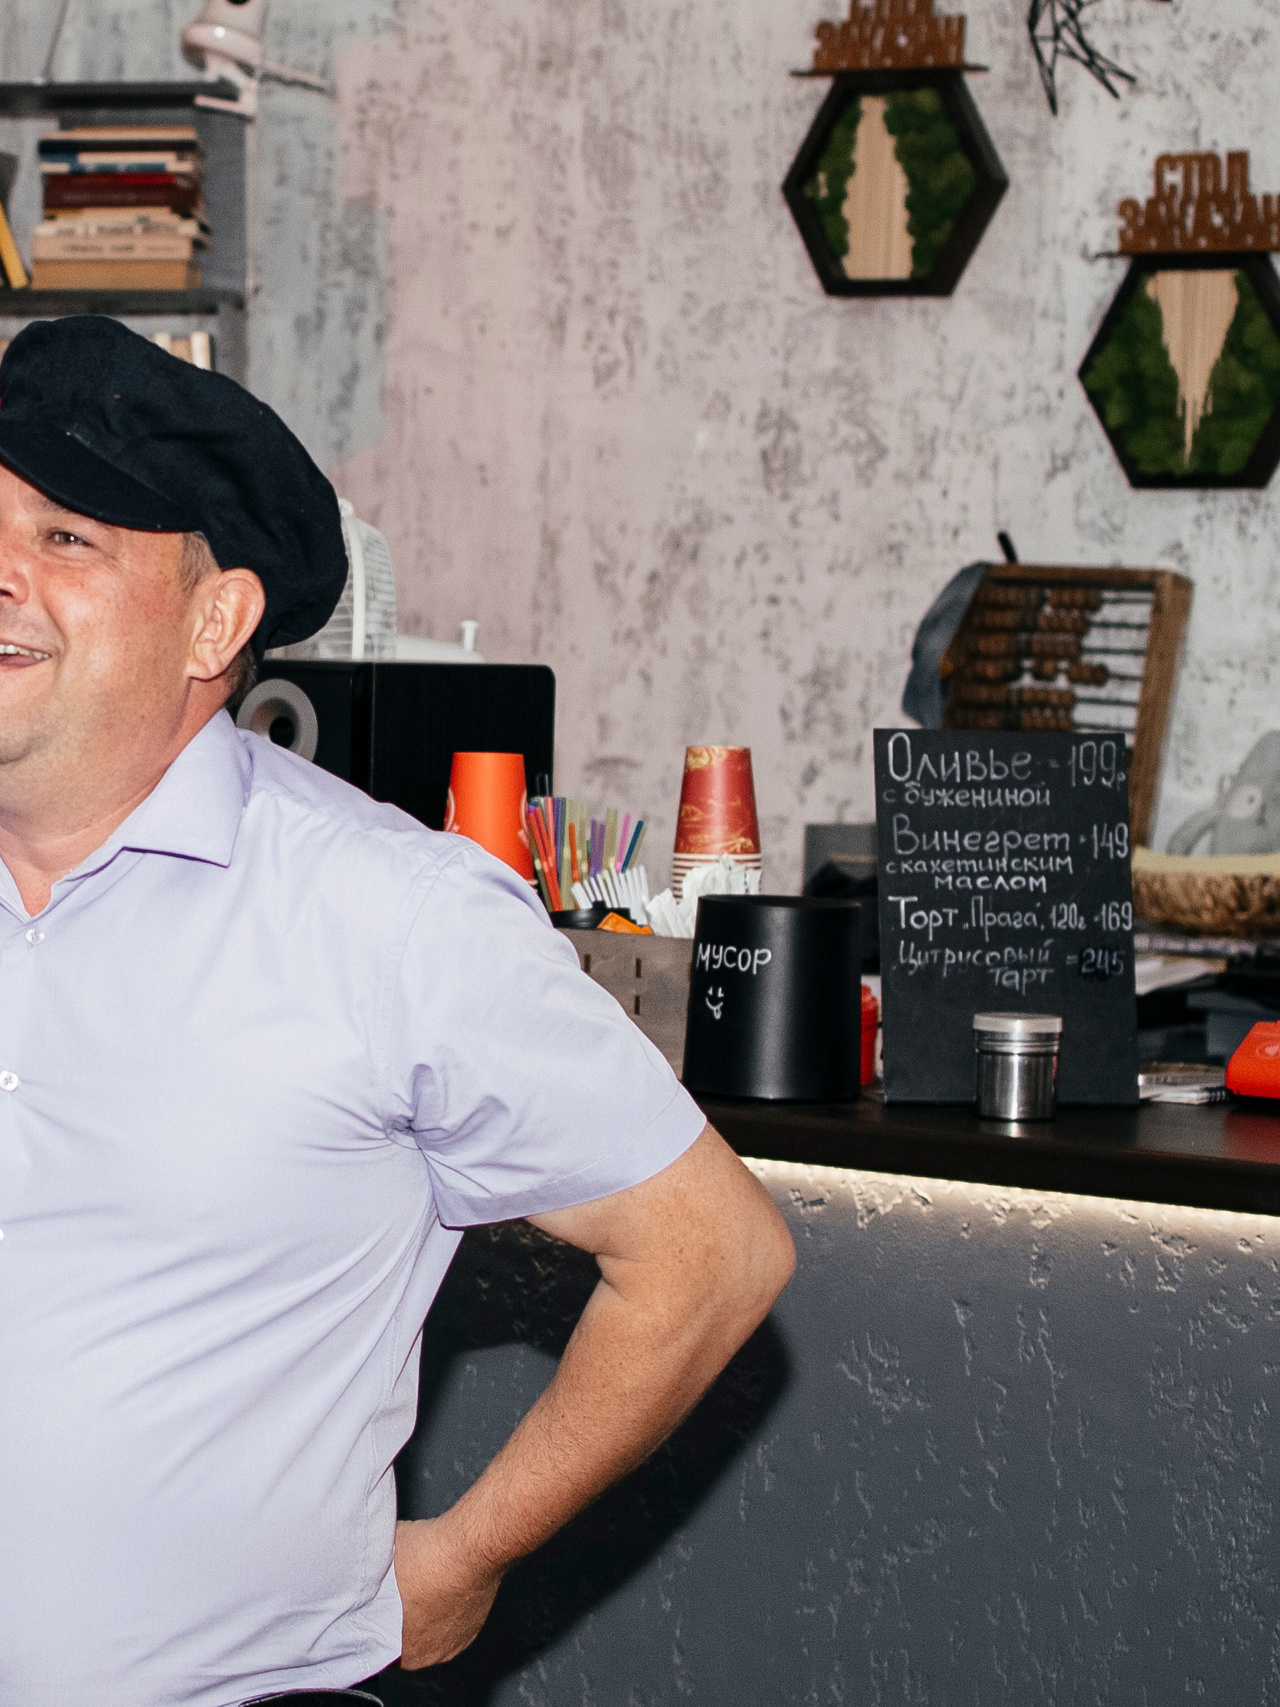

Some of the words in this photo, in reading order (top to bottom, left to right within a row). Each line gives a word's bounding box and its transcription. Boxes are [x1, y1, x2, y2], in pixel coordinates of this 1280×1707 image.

[888, 732, 1031, 783] Оливье
[905, 781, 1050, 808] бужениной
[893, 813, 1070, 860] Винегрет
[901, 856, 1074, 876] кахетинским
[934, 875, 1048, 893] маслом
[888, 896, 959, 942] Торт
[696, 942, 772, 975] МУСОР
[899, 939, 1054, 978] Цитрусовый
